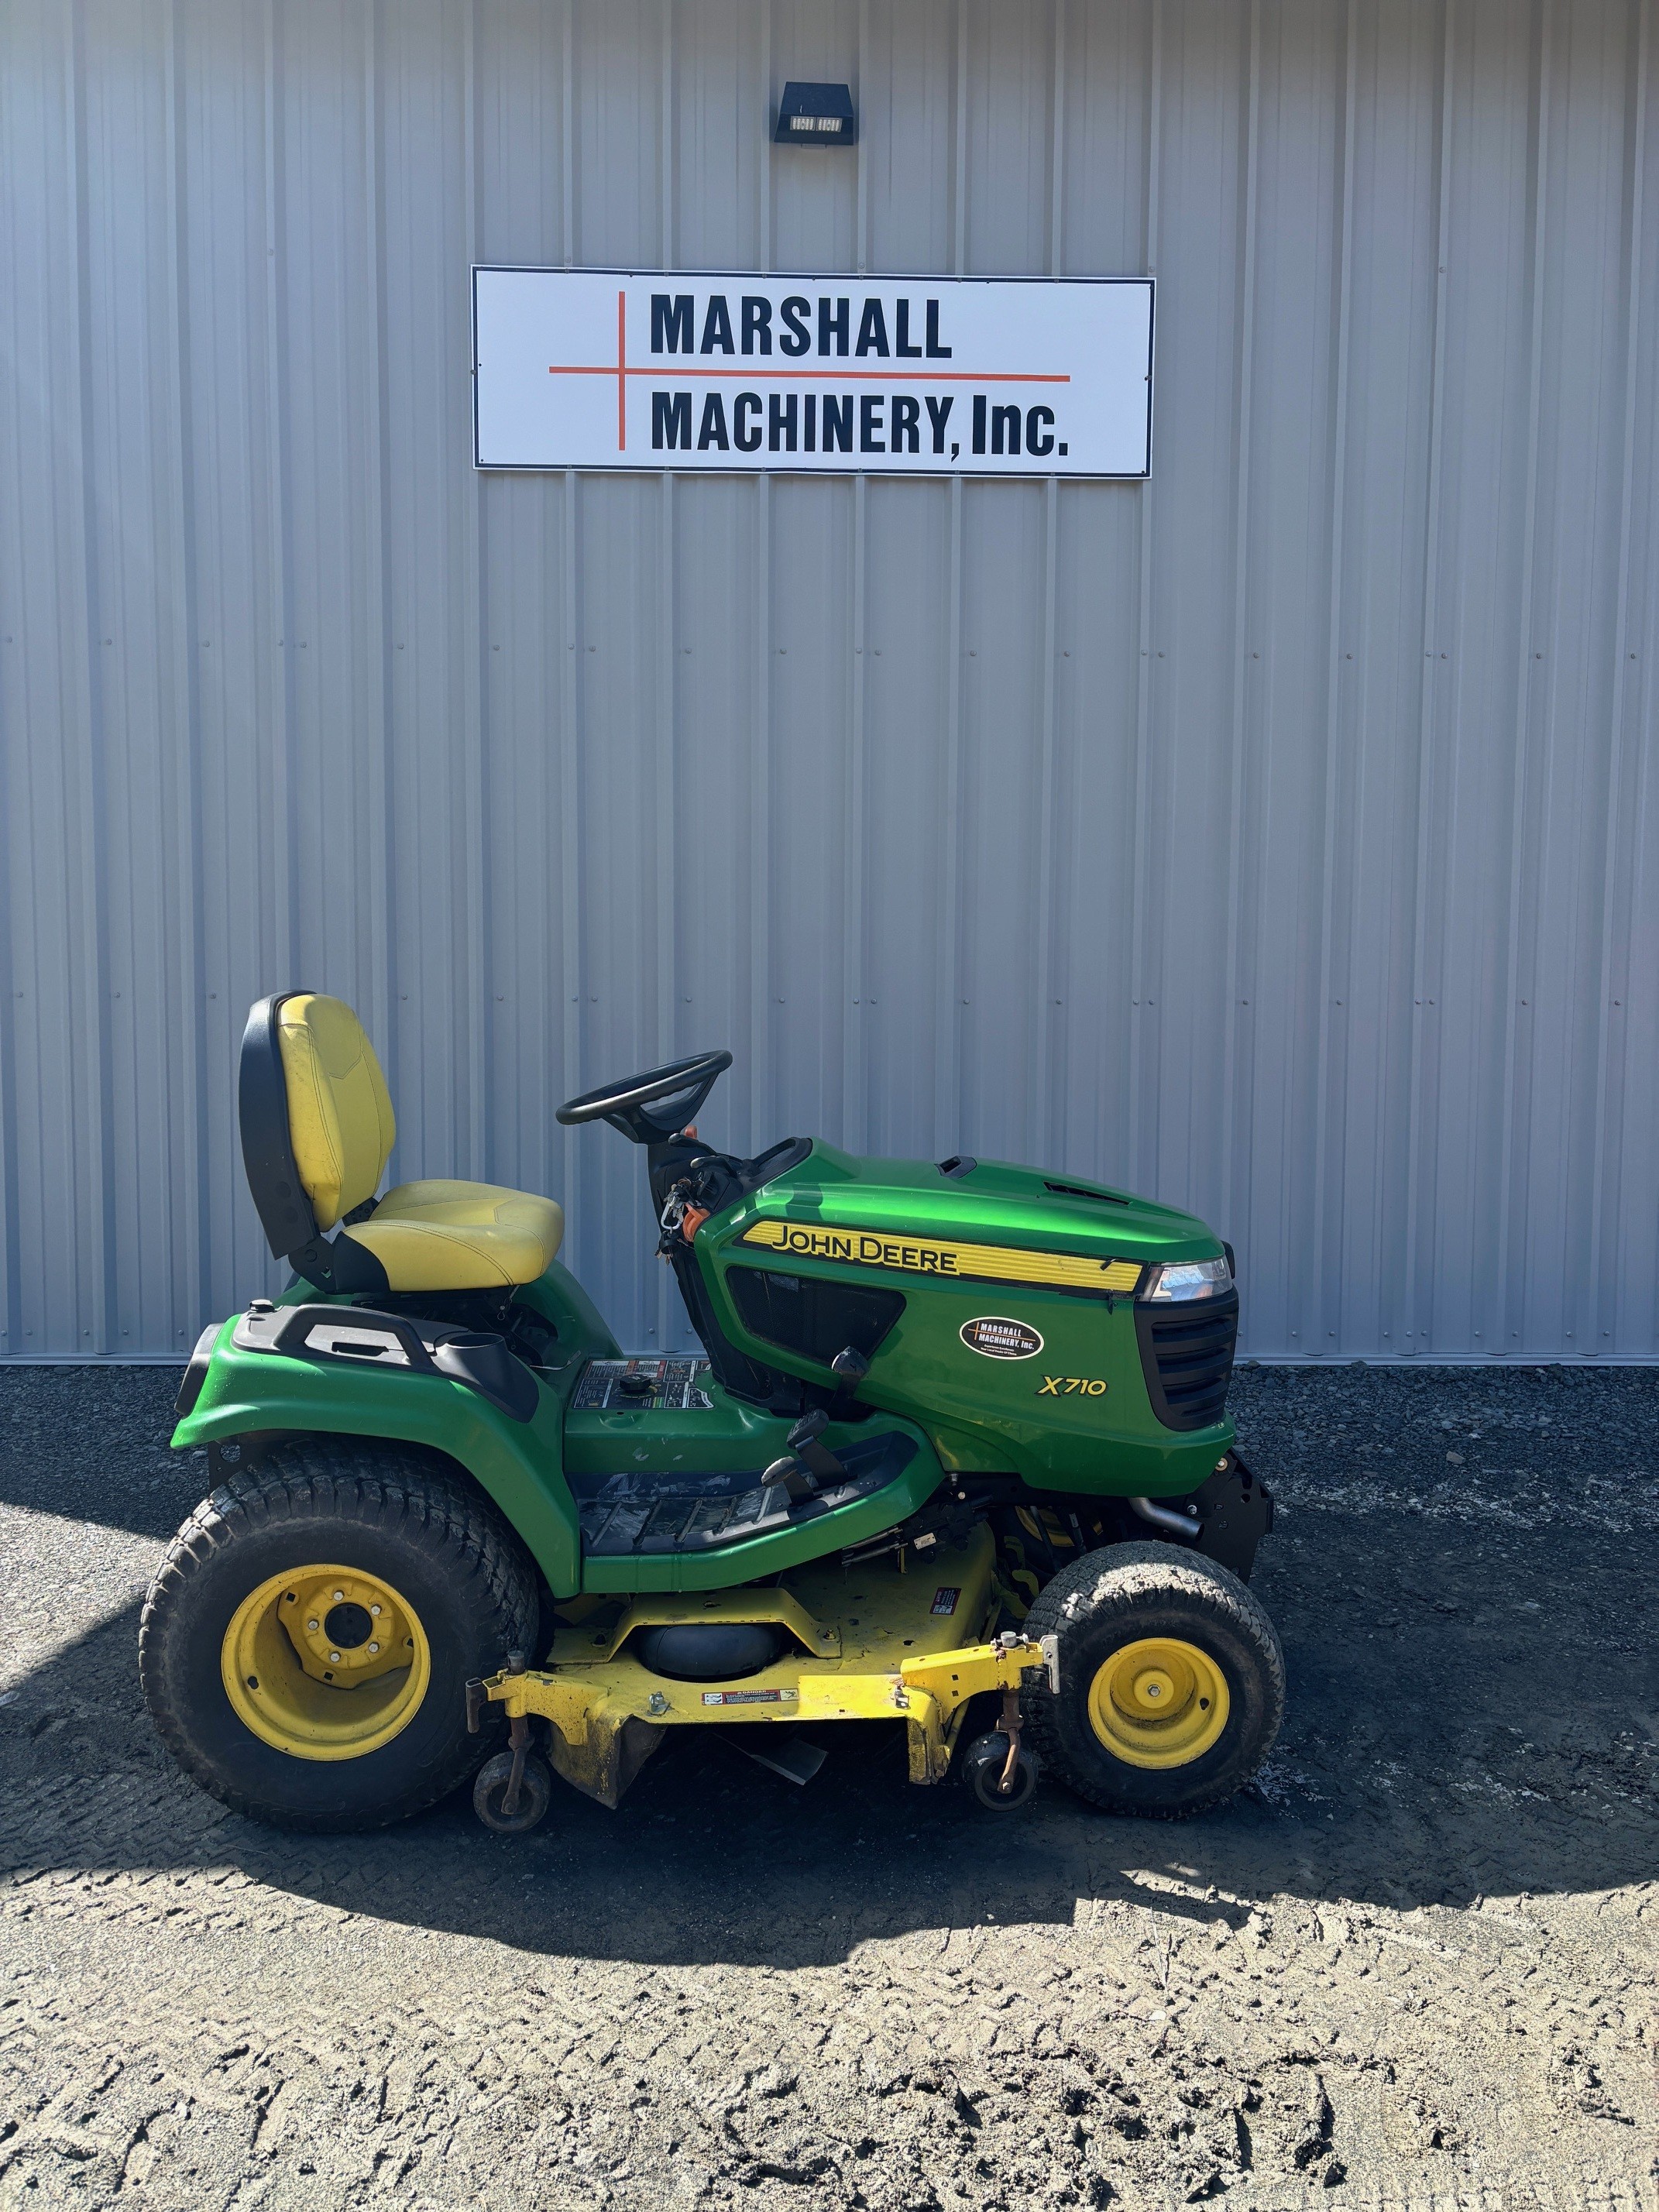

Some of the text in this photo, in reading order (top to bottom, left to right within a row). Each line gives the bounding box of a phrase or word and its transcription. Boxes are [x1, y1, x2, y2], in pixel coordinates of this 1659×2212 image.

[651, 294, 952, 358] MARSHALL
[652, 392, 1067, 462] MACHINERY, Inc.
[772, 1225, 957, 1272] JOHN DEERE
[981, 1323, 1022, 1337] MARSHALL
[1021, 1341, 1034, 1350] Inc.
[1038, 1376, 1107, 1396] X710
